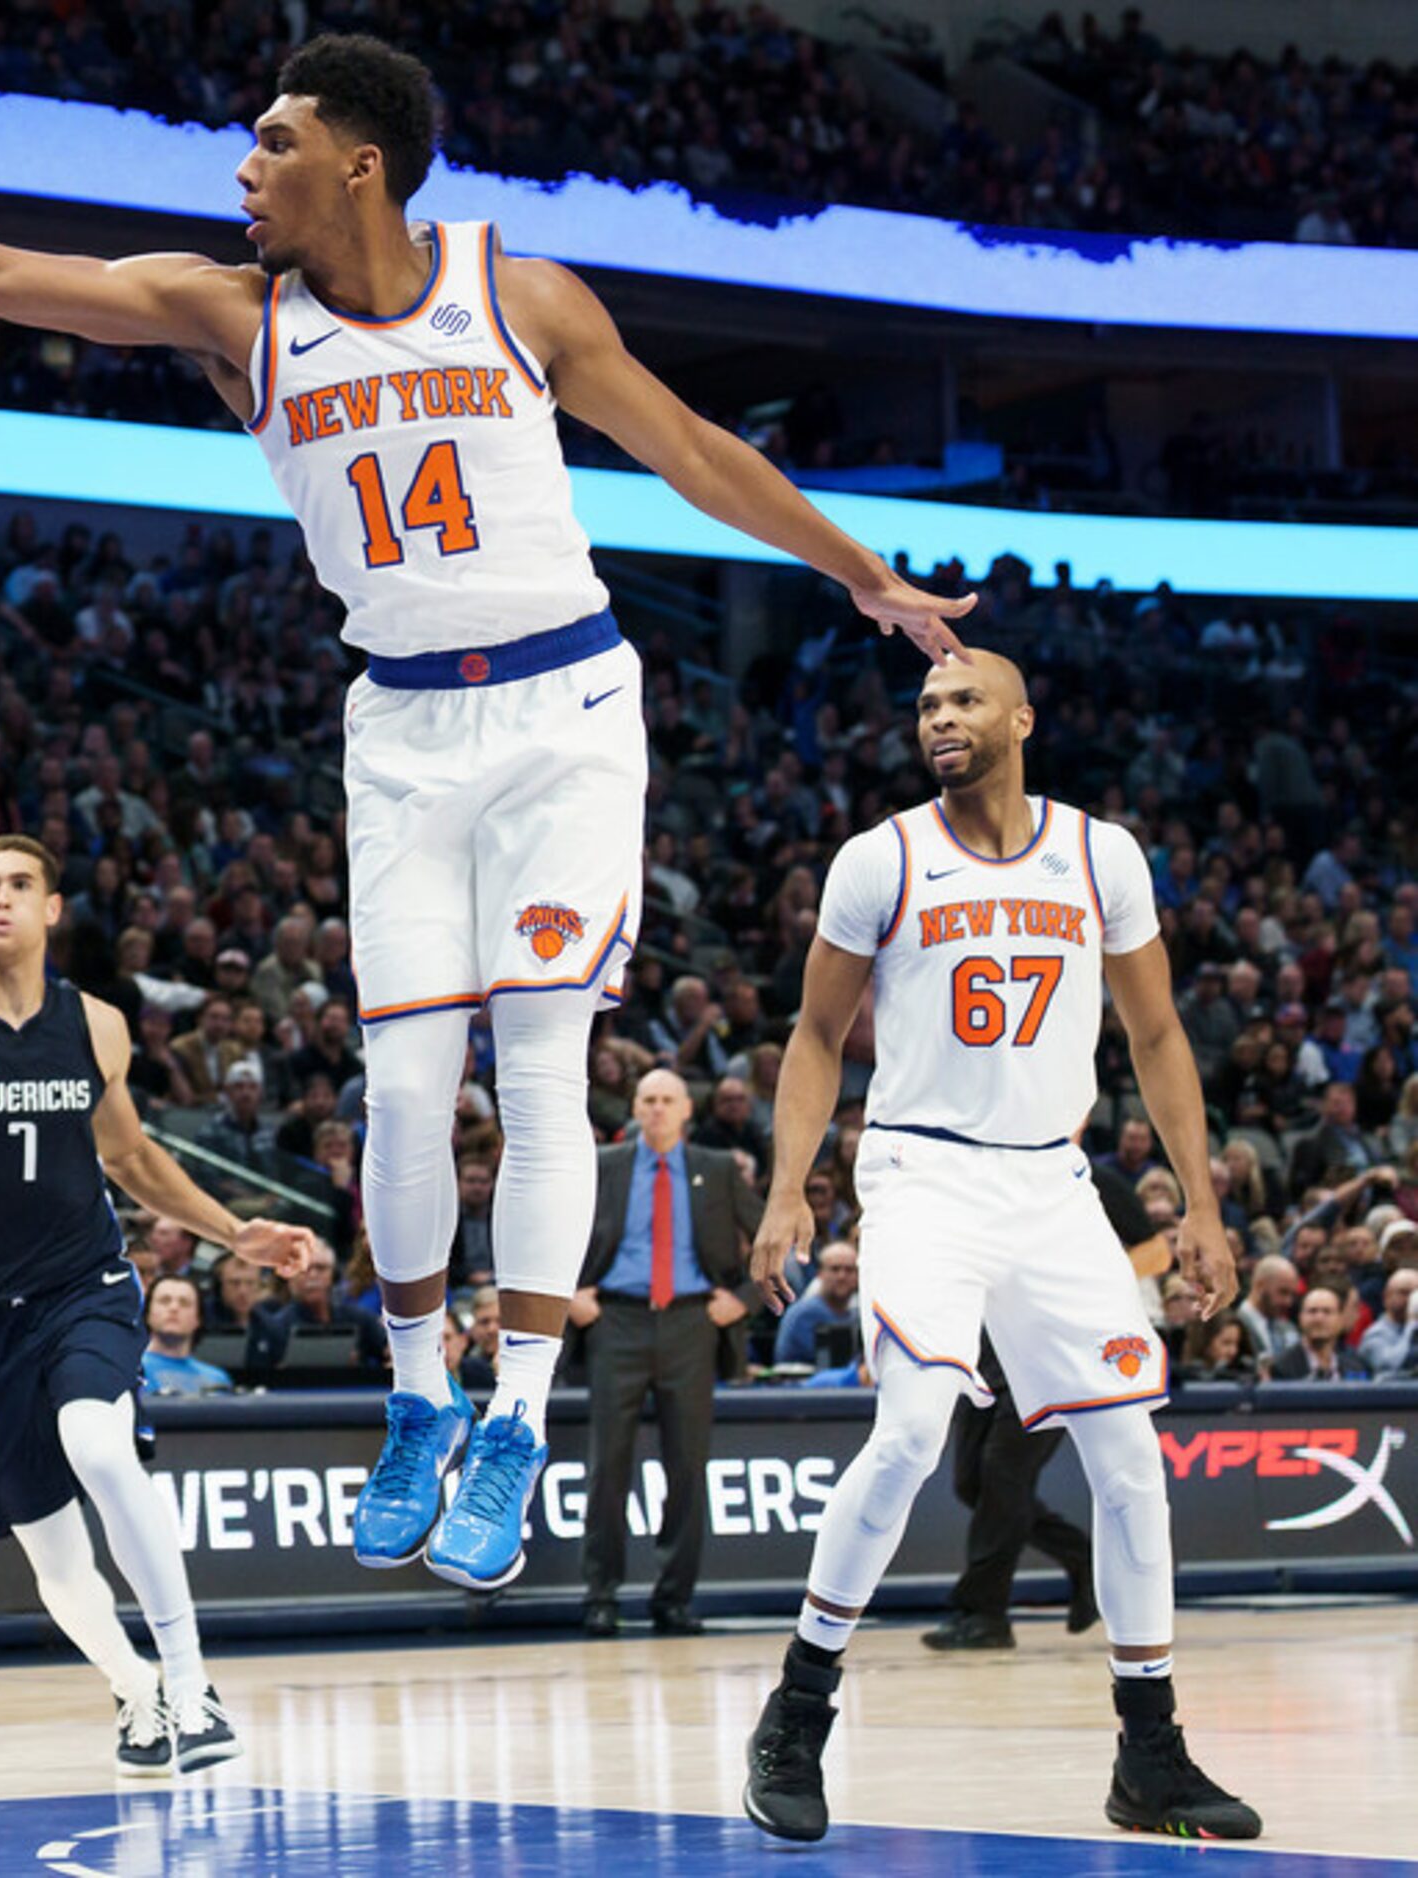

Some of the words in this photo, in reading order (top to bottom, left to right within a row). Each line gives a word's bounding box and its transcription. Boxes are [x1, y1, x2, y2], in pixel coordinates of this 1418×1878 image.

[282, 376, 382, 446] NEW
[388, 368, 513, 421] YORK
[346, 439, 480, 569] 14
[919, 900, 997, 948] NEW
[1000, 899, 1086, 946] YORK
[951, 955, 1064, 1047] 67
[7, 1121, 37, 1182] 7
[542, 1457, 837, 1538] GERS
[1159, 1425, 1413, 1546] YPERX
